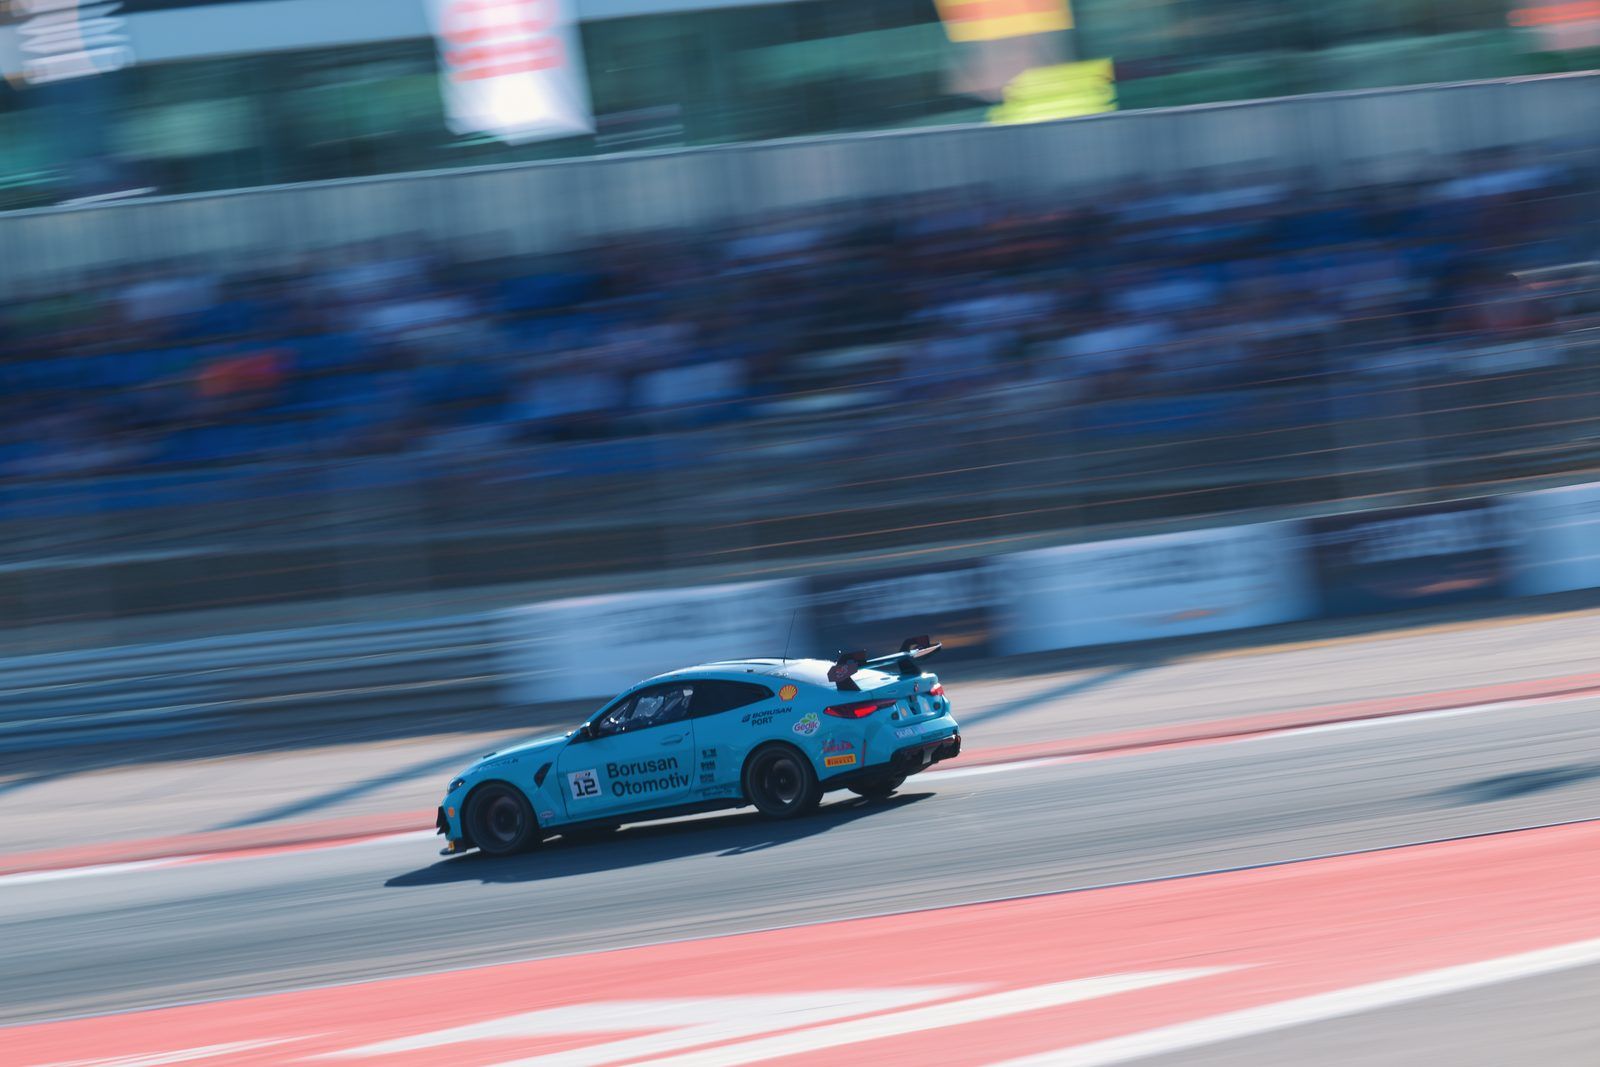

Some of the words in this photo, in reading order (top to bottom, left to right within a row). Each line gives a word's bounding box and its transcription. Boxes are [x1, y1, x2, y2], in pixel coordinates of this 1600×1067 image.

[752, 706, 792, 718] BORUSAN
[752, 716, 773, 726] PORT
[606, 756, 678, 779] Borusan
[574, 778, 598, 797] 12
[611, 772, 689, 797] Otomotiv
